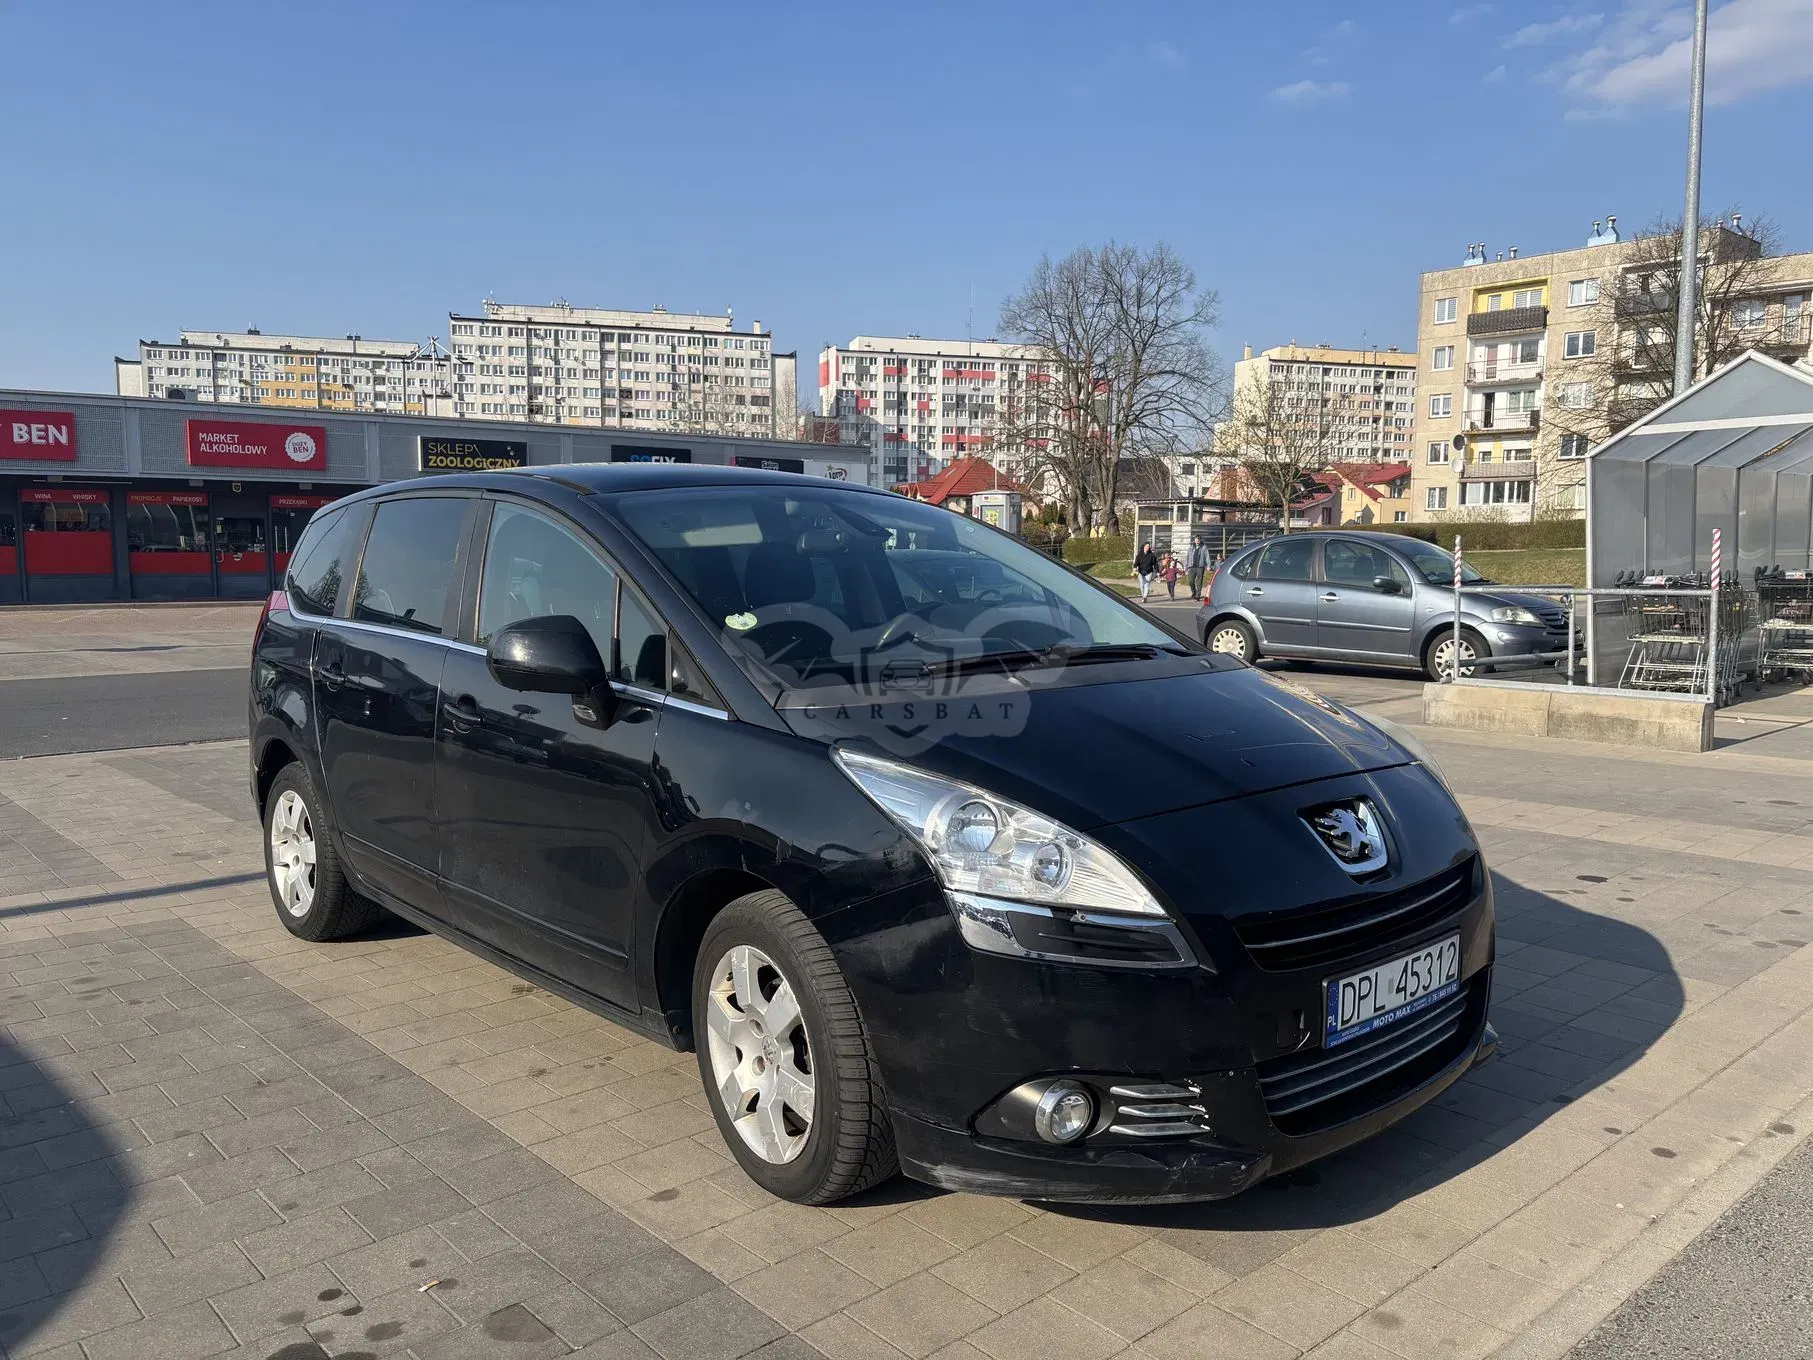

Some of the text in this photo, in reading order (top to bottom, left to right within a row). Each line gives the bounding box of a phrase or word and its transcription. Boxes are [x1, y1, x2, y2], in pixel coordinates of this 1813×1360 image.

[12, 422, 69, 446] BEN
[198, 432, 240, 443] MARKET
[199, 443, 268, 455] ALKOHOLOWY
[428, 442, 474, 455] SKLEP
[428, 456, 520, 469] ZOOLOGICZNY
[1340, 940, 1457, 1028] DPL 45312
[1327, 1014, 1337, 1028] PL
[1372, 1005, 1411, 1029] MOTO MAX
